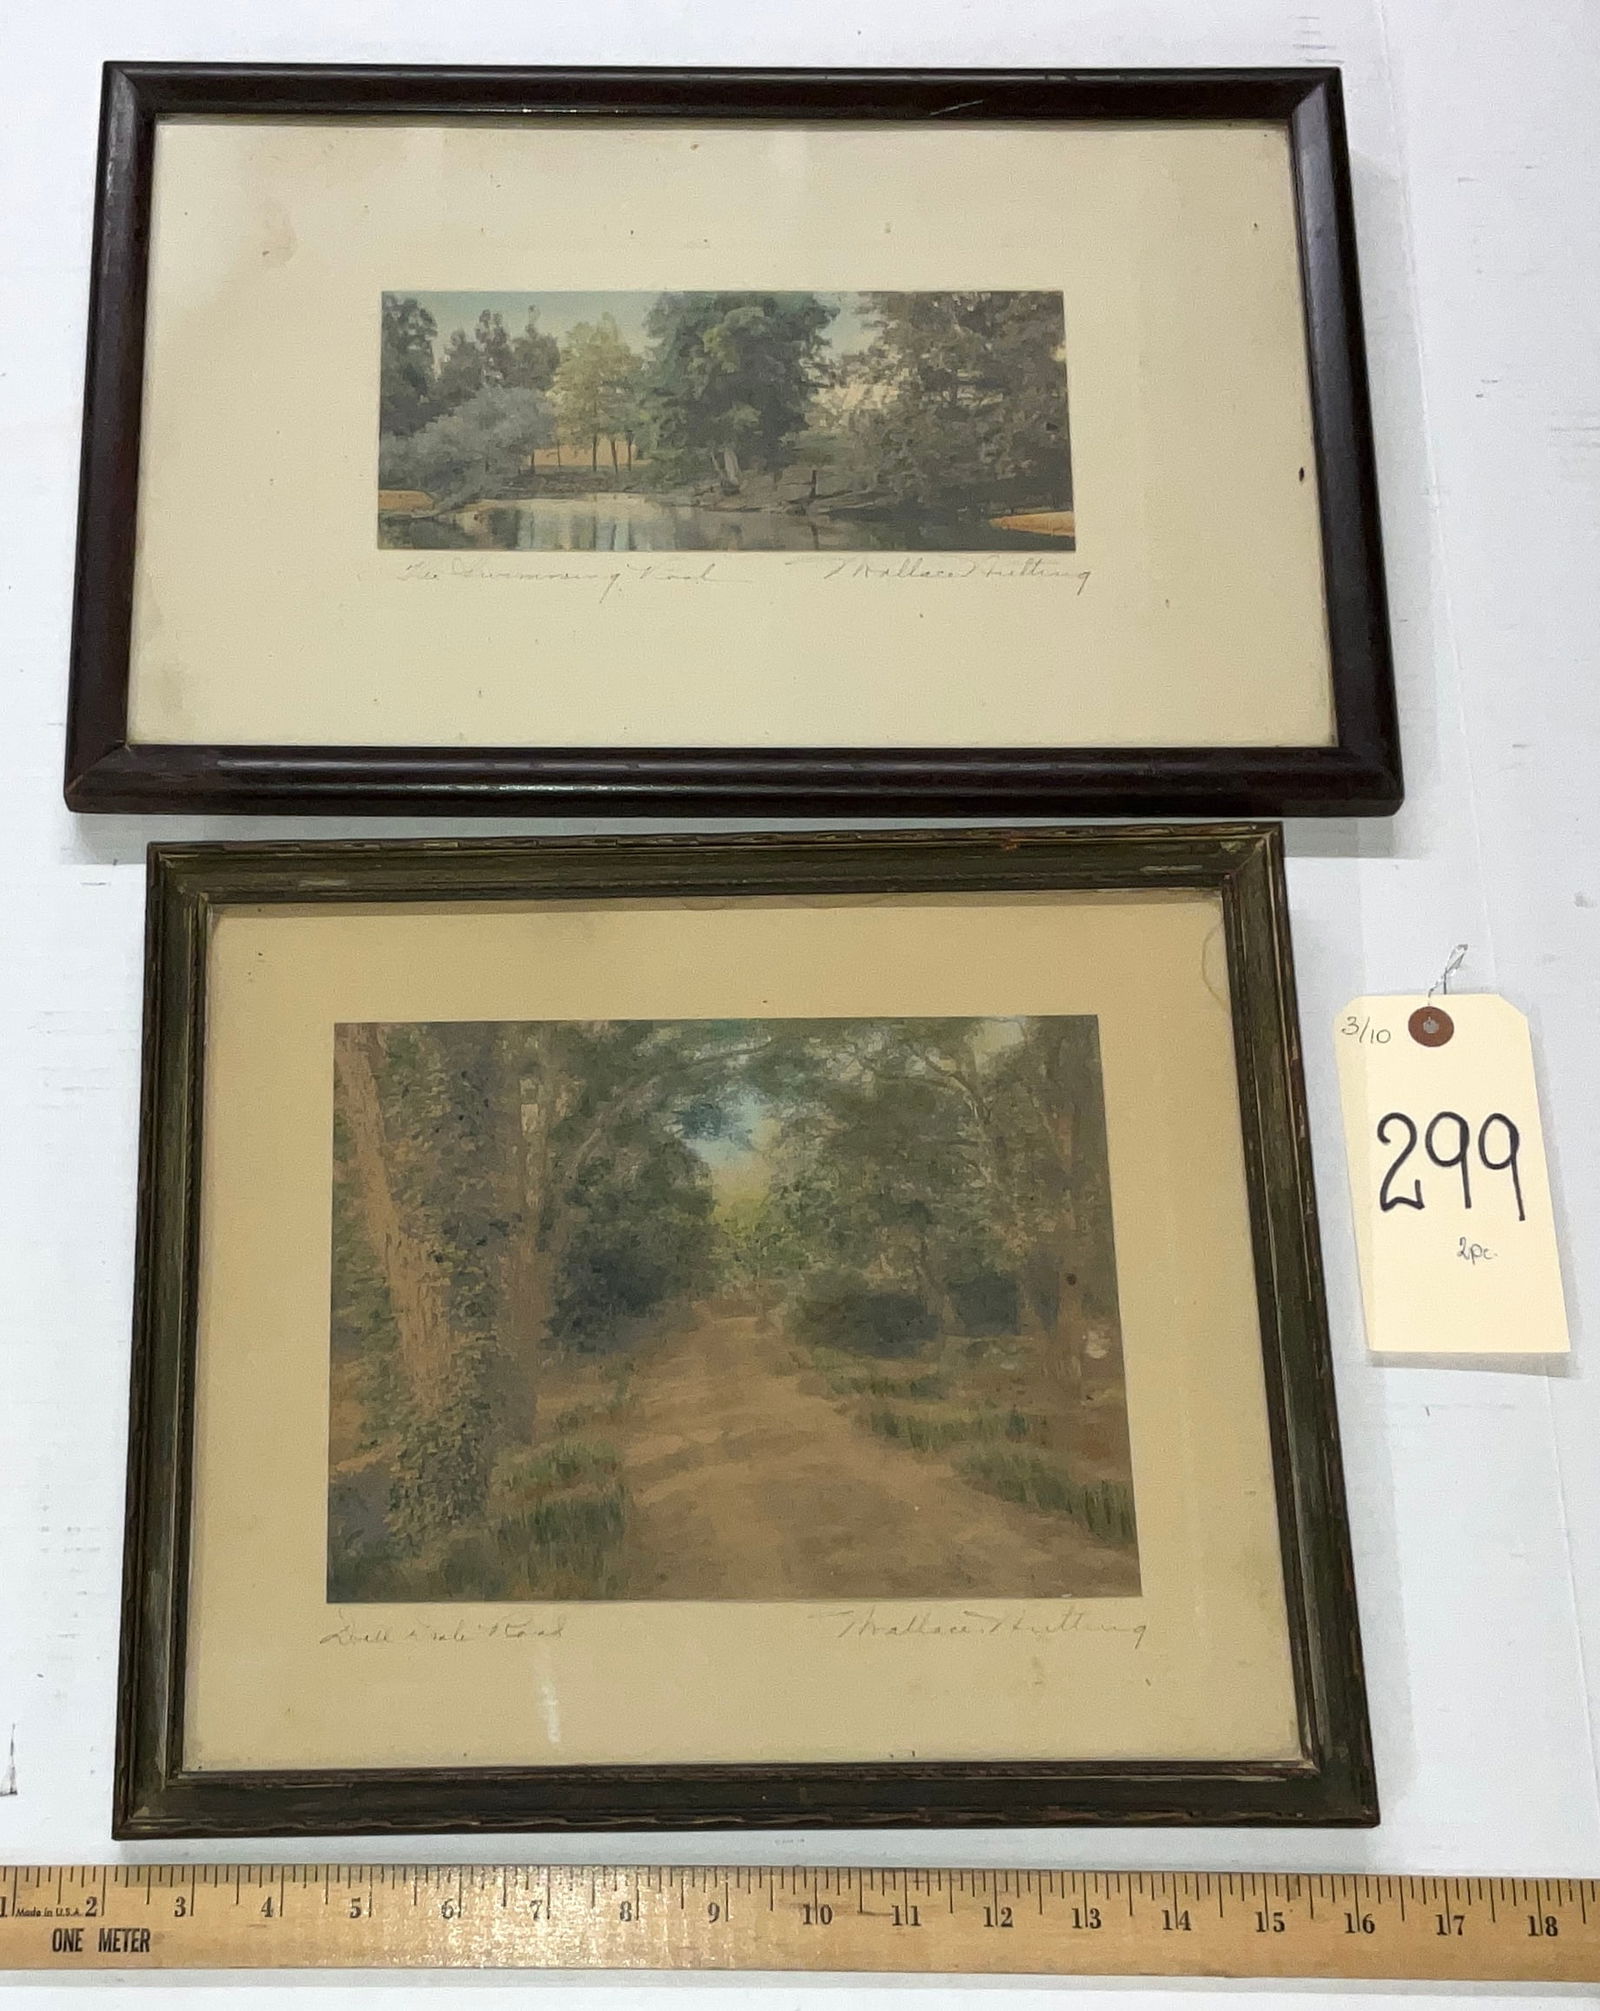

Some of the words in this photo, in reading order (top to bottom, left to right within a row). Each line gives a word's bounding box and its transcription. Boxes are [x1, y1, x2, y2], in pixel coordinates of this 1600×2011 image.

[1341, 1015, 1392, 1046] 3/10
[1376, 1110, 1526, 1222] 299
[16, 1906, 41, 1918] Made
[44, 1906, 53, 1918] in
[56, 1908, 82, 1918] U.S.A.
[85, 1896, 98, 1918] 2
[174, 1896, 187, 1918] 3
[260, 1896, 273, 1918] 4
[349, 1898, 362, 1918] 5
[440, 1899, 455, 1919] 6
[529, 1901, 543, 1921] 7
[618, 1901, 633, 1922] 8
[707, 1902, 720, 1924] 9
[802, 1904, 834, 1926] 10
[892, 1904, 922, 1927] 11
[983, 1906, 1014, 1929] 12
[1072, 1907, 1102, 1930] 13
[1162, 1909, 1192, 1932] 14
[1255, 1911, 1286, 1934] 15
[1344, 1912, 1376, 1935] 16
[1436, 1914, 1465, 1937] 17
[1527, 1915, 1559, 1938] 18
[52, 1928, 85, 1953] ONE
[98, 1928, 151, 1953] METER
